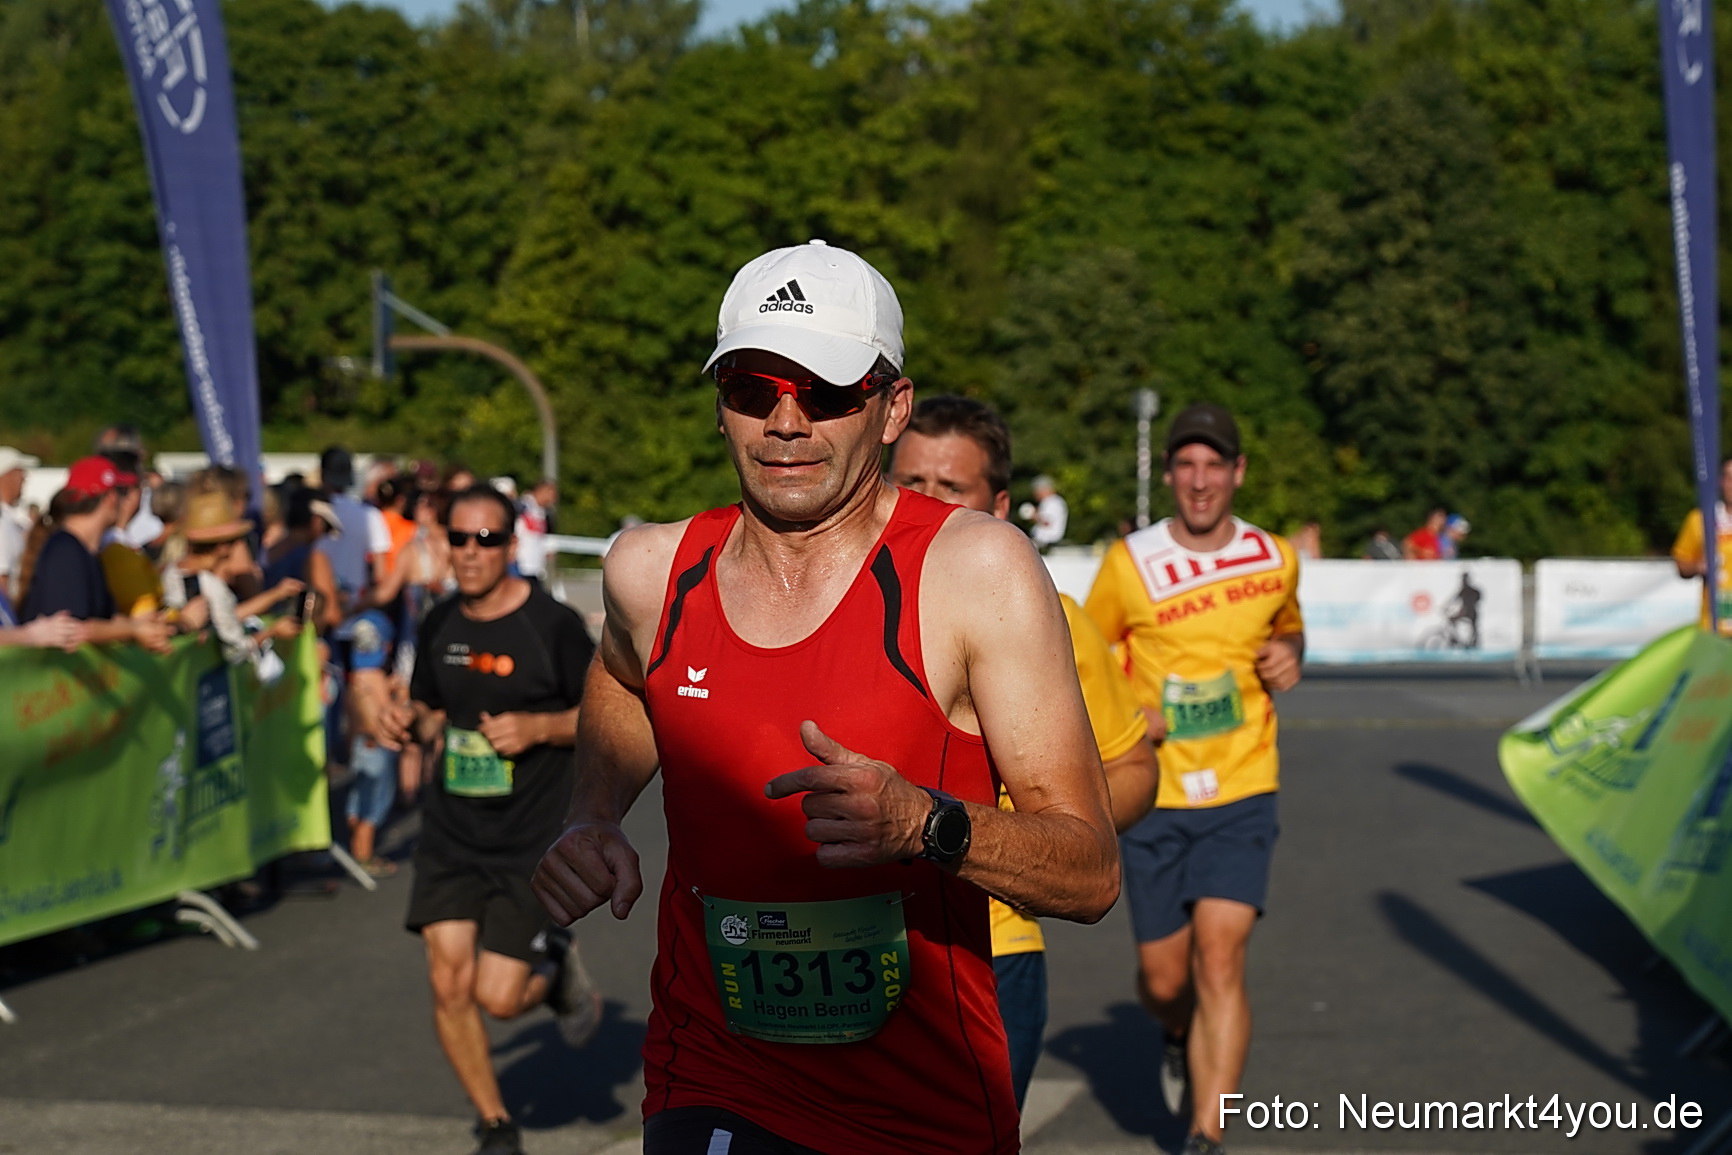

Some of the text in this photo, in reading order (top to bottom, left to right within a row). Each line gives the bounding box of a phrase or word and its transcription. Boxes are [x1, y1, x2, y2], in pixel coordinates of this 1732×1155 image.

[758, 299, 814, 315] adidas
[1158, 594, 1216, 624] MAX
[677, 684, 710, 699] erima
[751, 927, 811, 940] Firmenlauf
[775, 937, 811, 946] neumarkt
[742, 950, 876, 998] 1313
[880, 950, 902, 1011] 2022
[720, 962, 743, 1009] RUN
[753, 999, 871, 1020] Hagen Bernd
